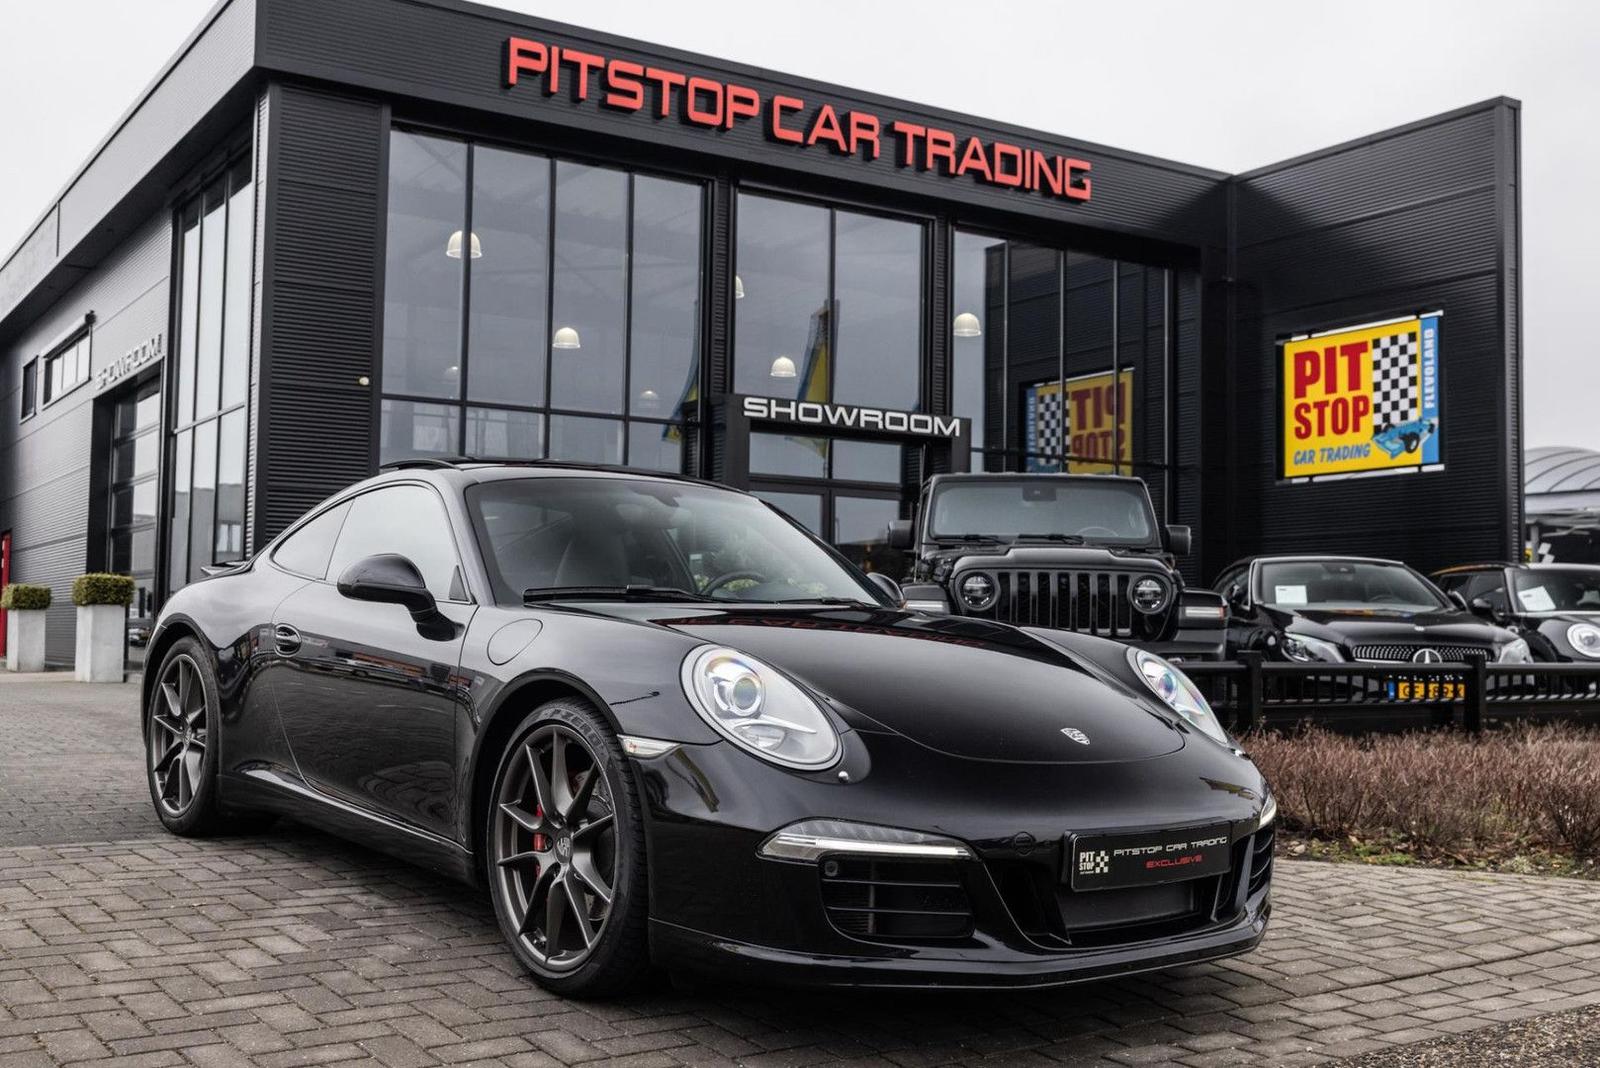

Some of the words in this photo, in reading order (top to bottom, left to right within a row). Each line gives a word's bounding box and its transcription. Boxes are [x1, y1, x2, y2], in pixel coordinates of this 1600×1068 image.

[507, 37, 760, 129] PITSTOP
[773, 95, 880, 160] CAR
[894, 121, 1092, 201] TRADING
[1294, 341, 1369, 399] PIT
[1423, 328, 1435, 409] FLEVOLAND
[743, 397, 961, 437] SHOWROOM
[1294, 395, 1370, 440] STOP
[1294, 450, 1316, 466] CAR
[1320, 443, 1371, 463] TRADING
[1080, 851, 1096, 862] PIT
[1113, 845, 1163, 857] PITSTOP
[1166, 843, 1188, 852] CAR
[1191, 836, 1228, 848] TRADING
[1146, 855, 1202, 869] EXCLUSIVE
[1079, 861, 1095, 871] STOP
